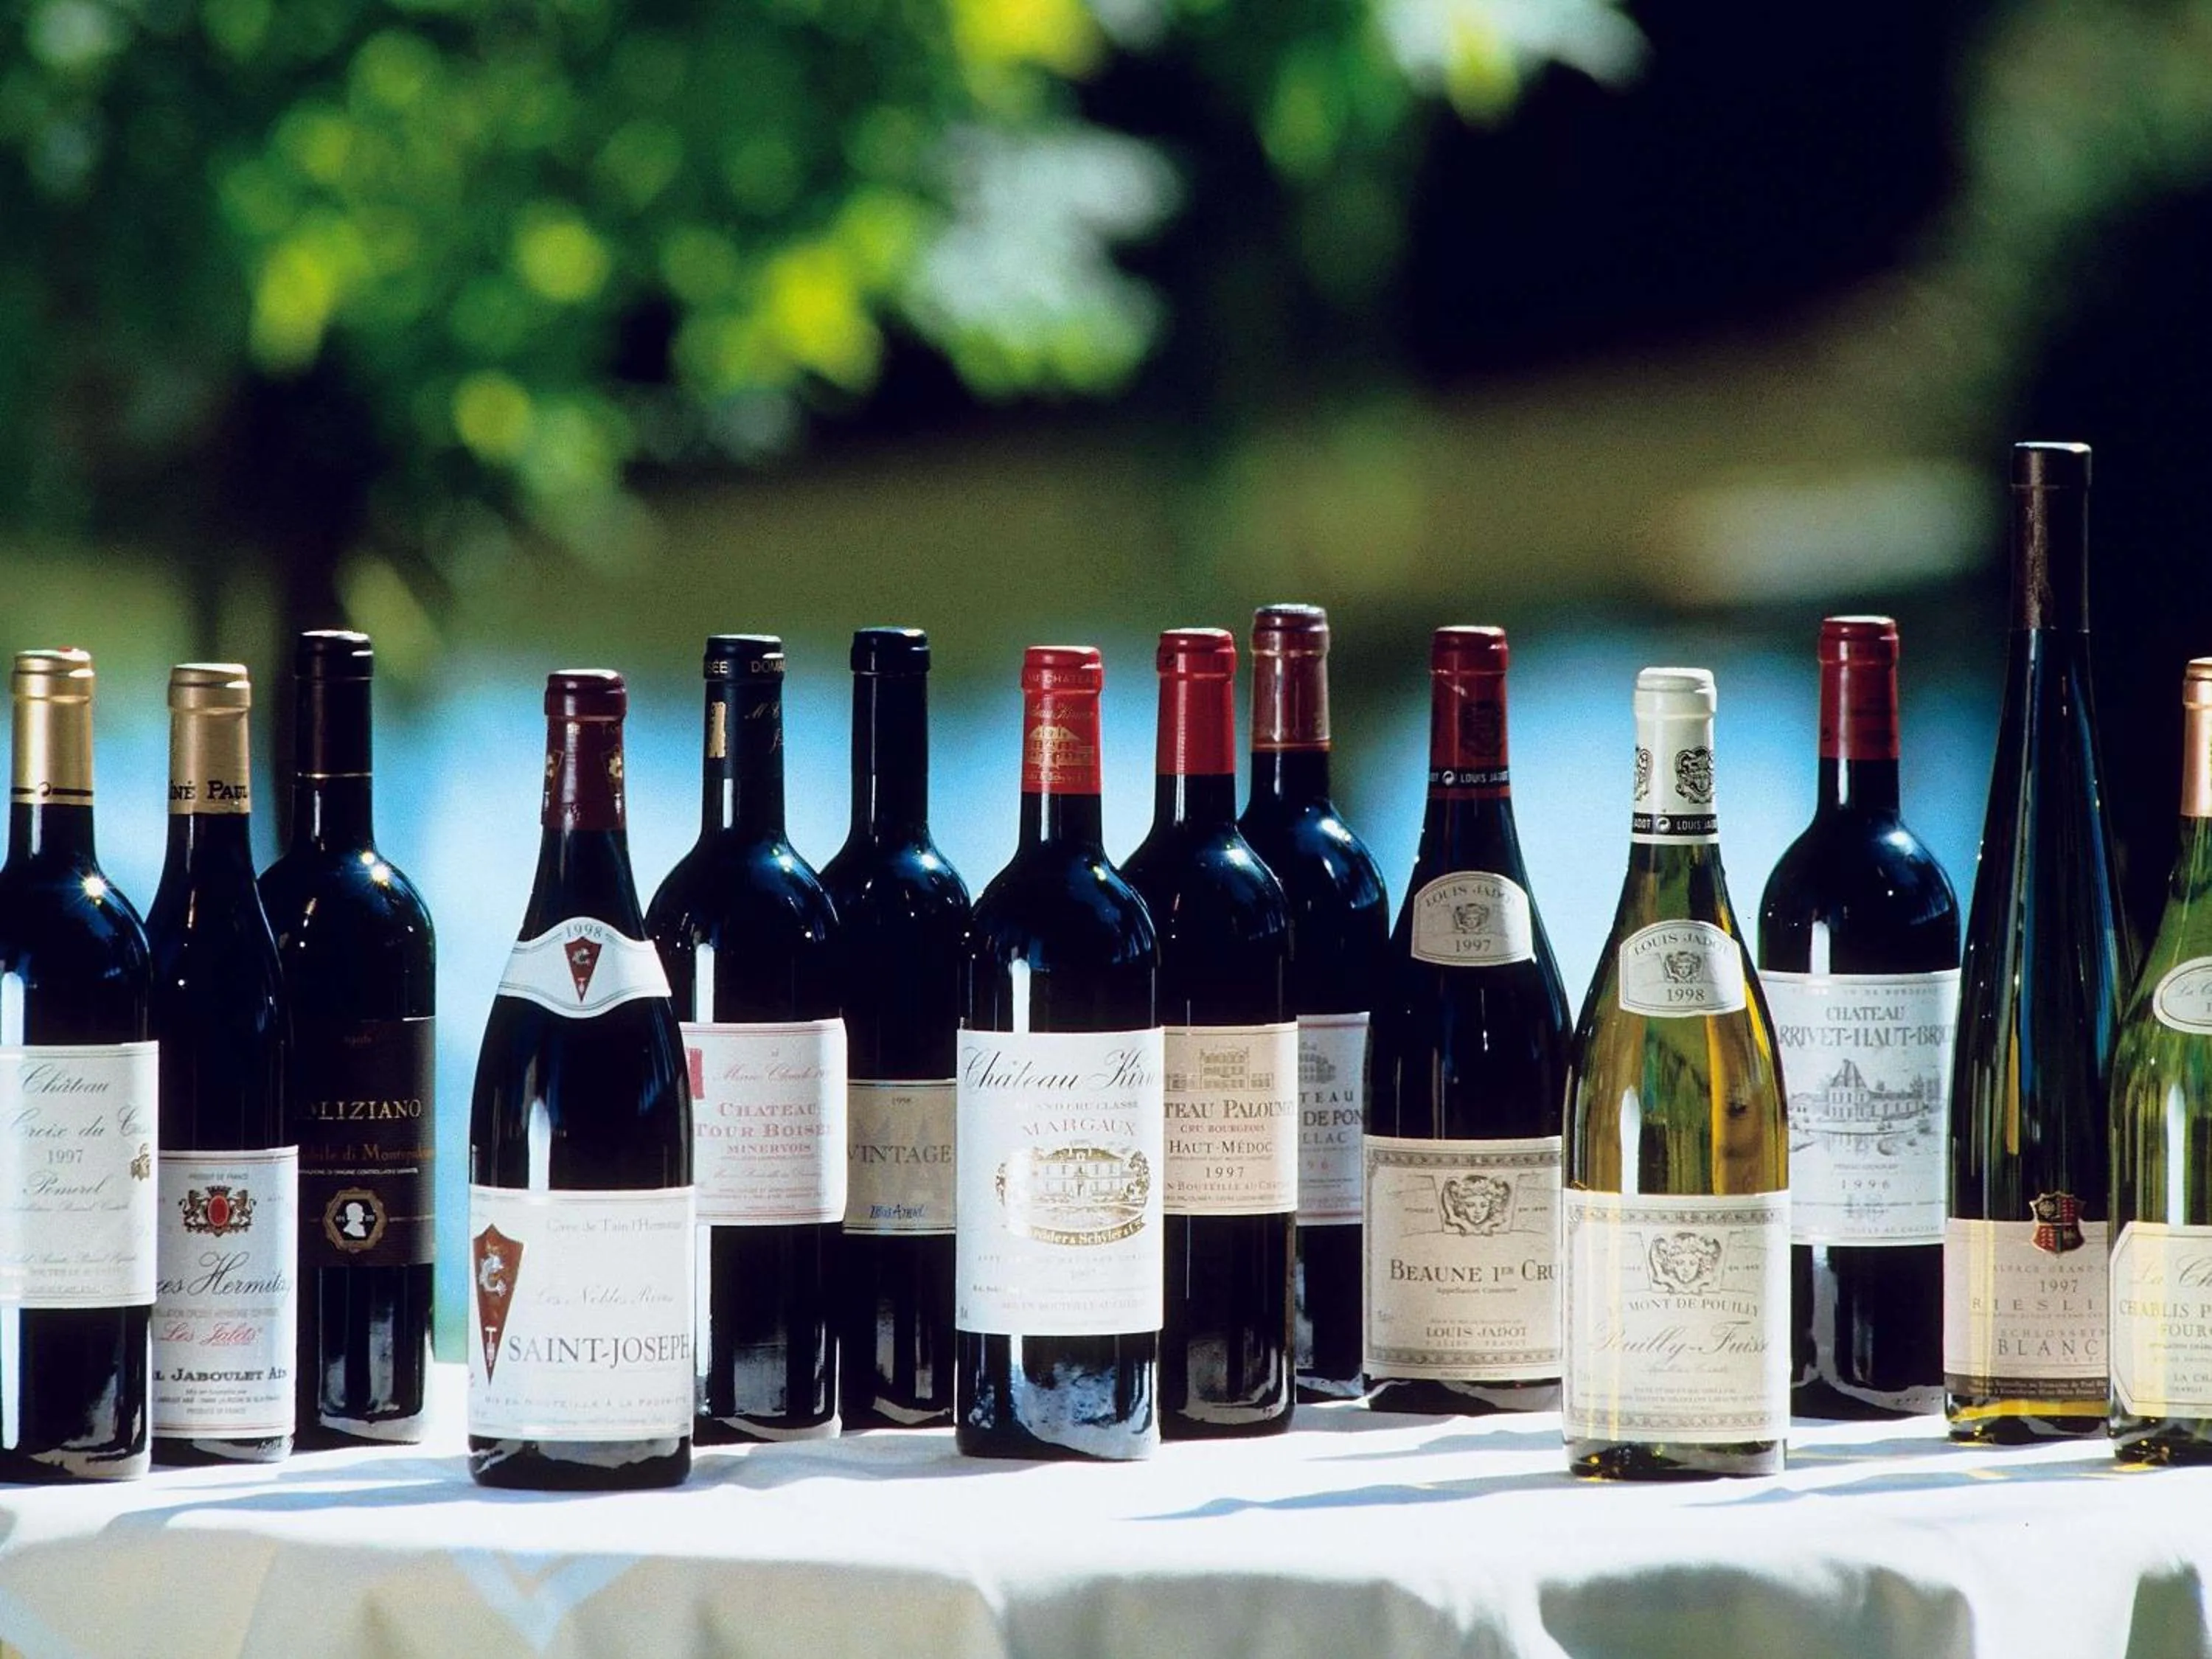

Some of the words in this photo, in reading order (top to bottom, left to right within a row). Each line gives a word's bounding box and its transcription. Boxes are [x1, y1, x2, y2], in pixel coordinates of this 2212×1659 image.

[1460, 773, 1486, 784] LOUIS
[1676, 819, 1702, 831] LOUIS
[1425, 886, 1467, 908] LOUIS
[566, 923, 603, 939] 1998
[1454, 939, 1491, 953] 1997
[1634, 933, 1678, 956] LOUIS
[1666, 989, 1705, 1002] 1998
[1826, 1006, 1905, 1022] CHATEAU
[311, 1098, 422, 1121] LIZIANO
[1022, 1118, 1138, 1136] MARGAUX
[47, 1149, 84, 1164] 1997
[848, 1144, 952, 1164] VINTAGE
[1206, 1166, 1245, 1179] 1997
[1390, 1258, 1482, 1283] BEAUNE
[2039, 1279, 2079, 1293] 1997
[1628, 1298, 1672, 1312] MONT
[1677, 1298, 1696, 1309] DE
[1700, 1299, 1759, 1317] POUILLY
[2118, 1299, 2190, 1318] CHABLIS
[1426, 1326, 1474, 1338] LOUIS
[1477, 1326, 1526, 1338] JADOT
[508, 1333, 691, 1369] SAINT-JOSEPH
[1590, 1321, 1770, 1364] Pouilly-Fuiss
[1997, 1339, 2098, 1357] BLANC
[170, 1367, 265, 1382] JABOULET
